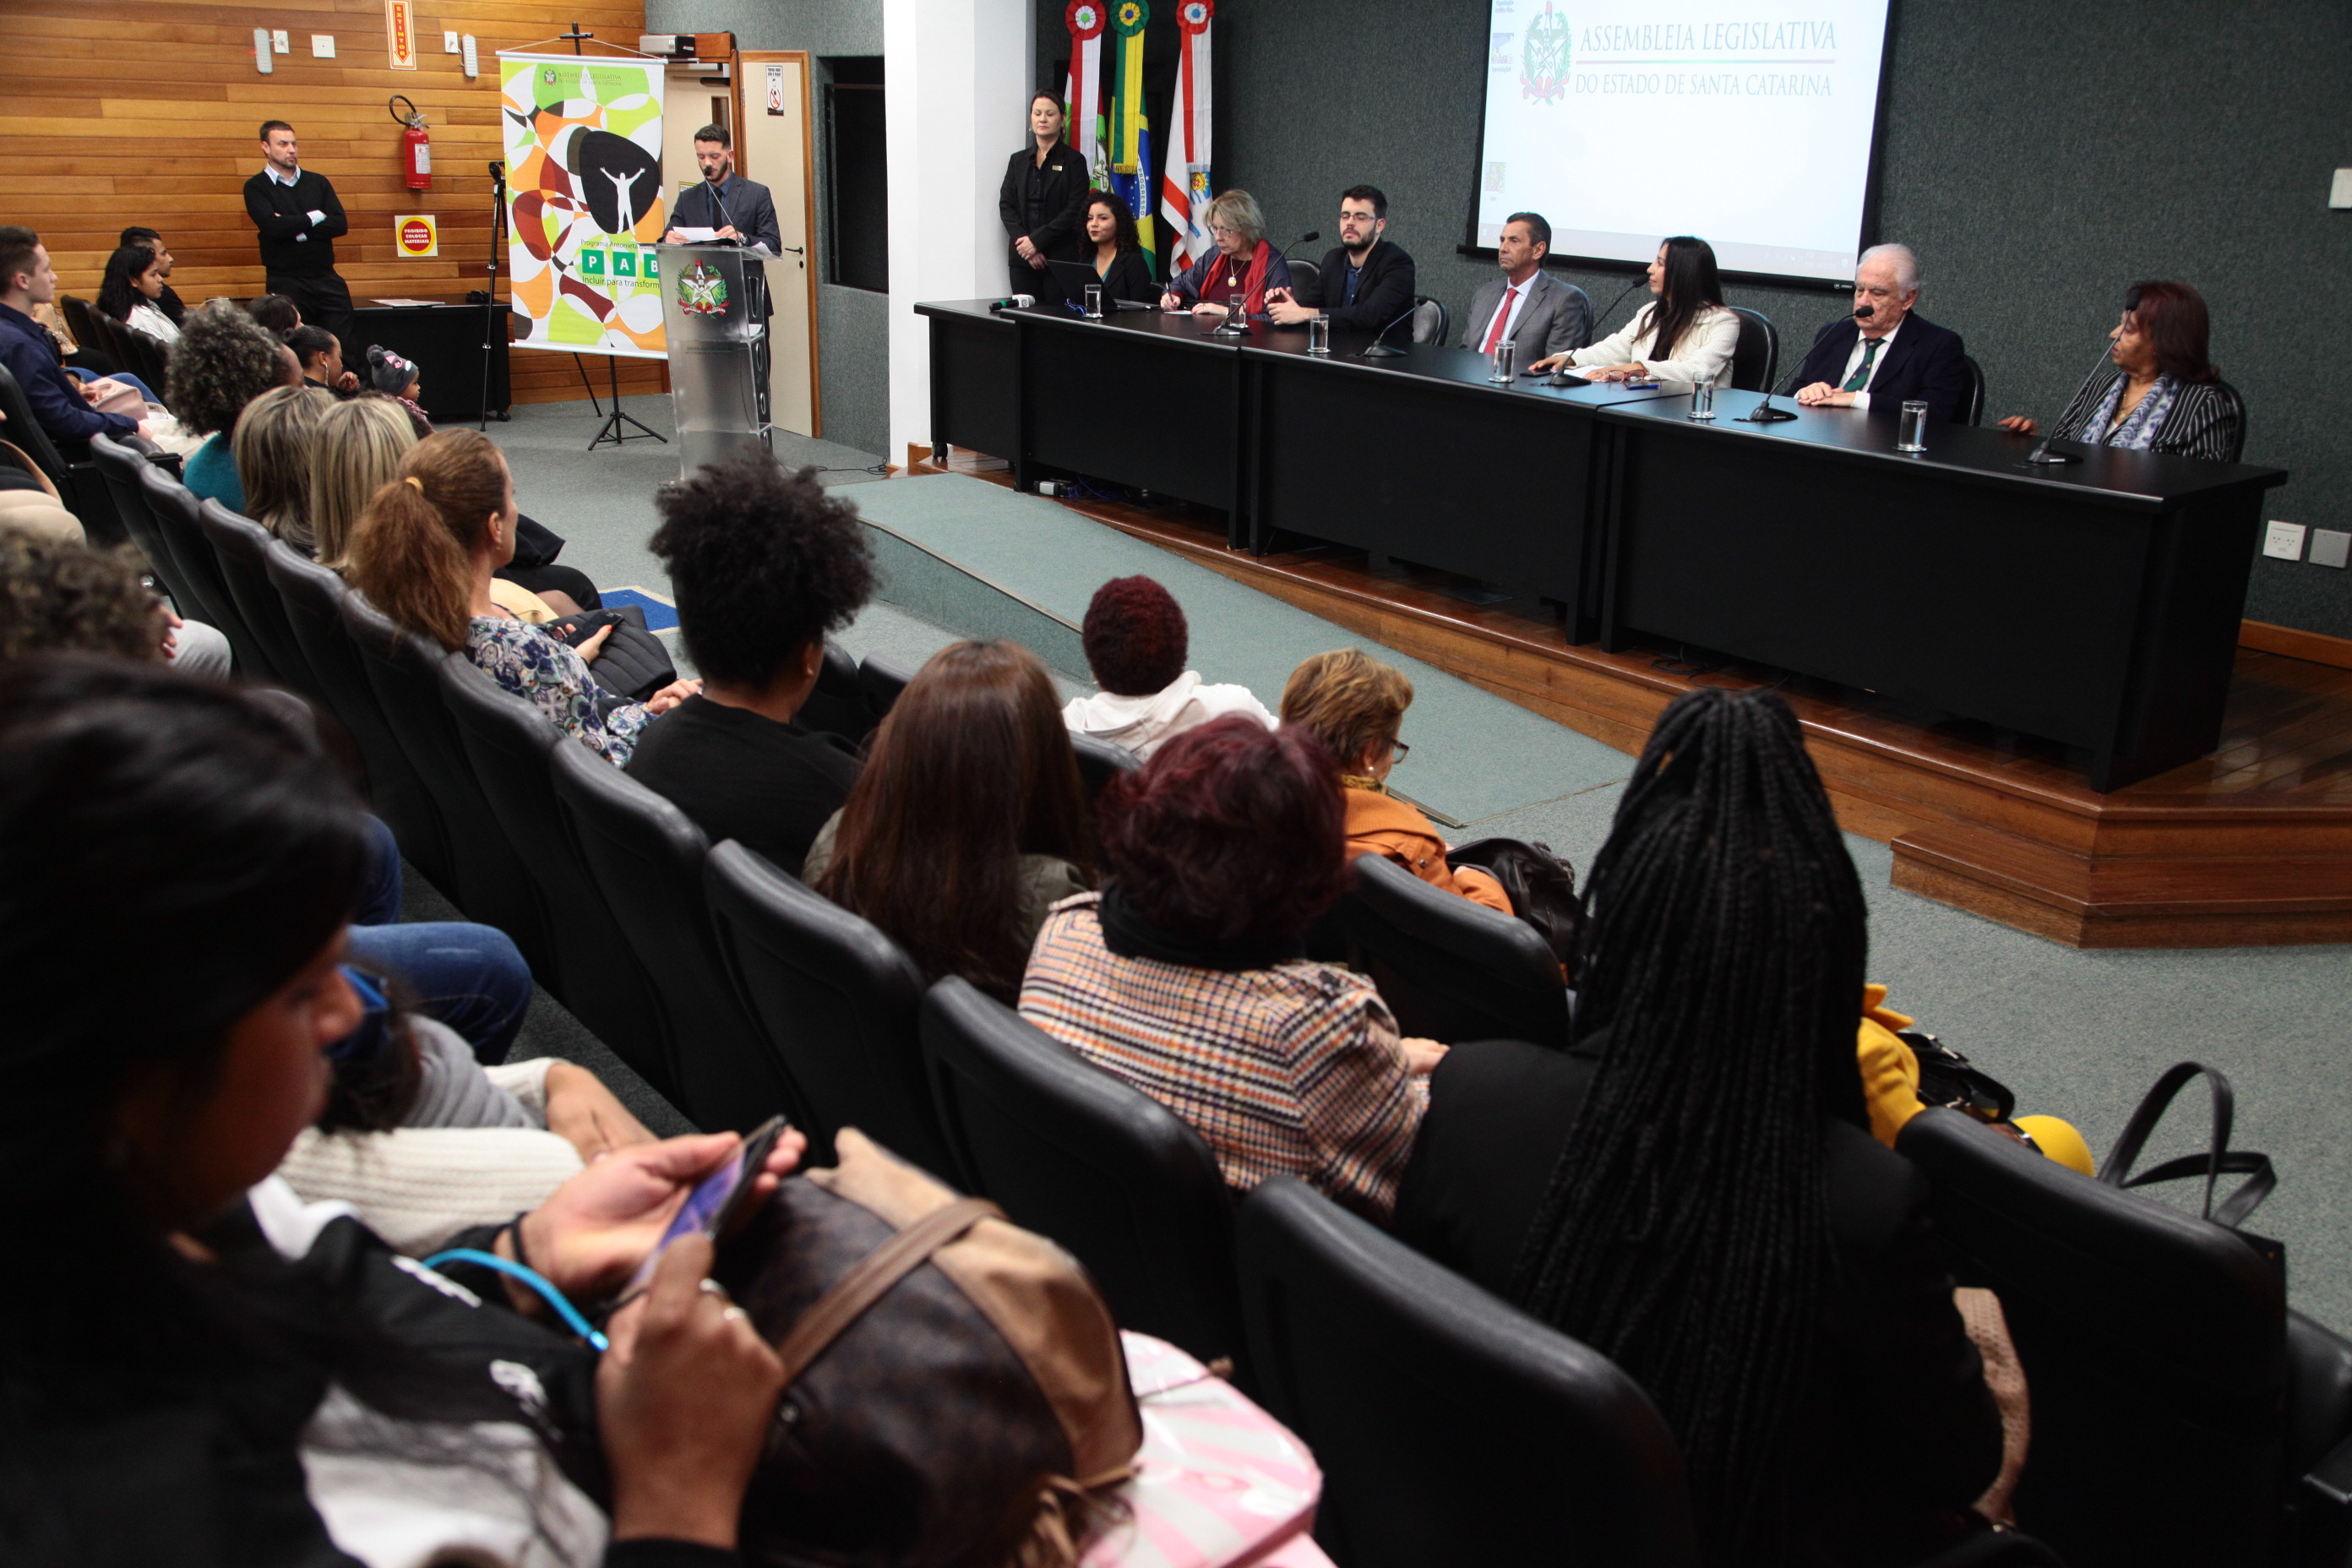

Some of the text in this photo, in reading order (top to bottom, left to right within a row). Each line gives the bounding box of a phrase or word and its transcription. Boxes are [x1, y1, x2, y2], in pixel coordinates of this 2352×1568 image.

[396, 6, 406, 56] EXTINTOR
[1580, 21, 1837, 52] ASSEMBLEIA LEGISLATIVA
[1576, 74, 1832, 96] DO ESTADO DE SANTA CATARINA
[580, 239, 608, 248] Programa
[582, 276, 660, 289] Incluir para transform
